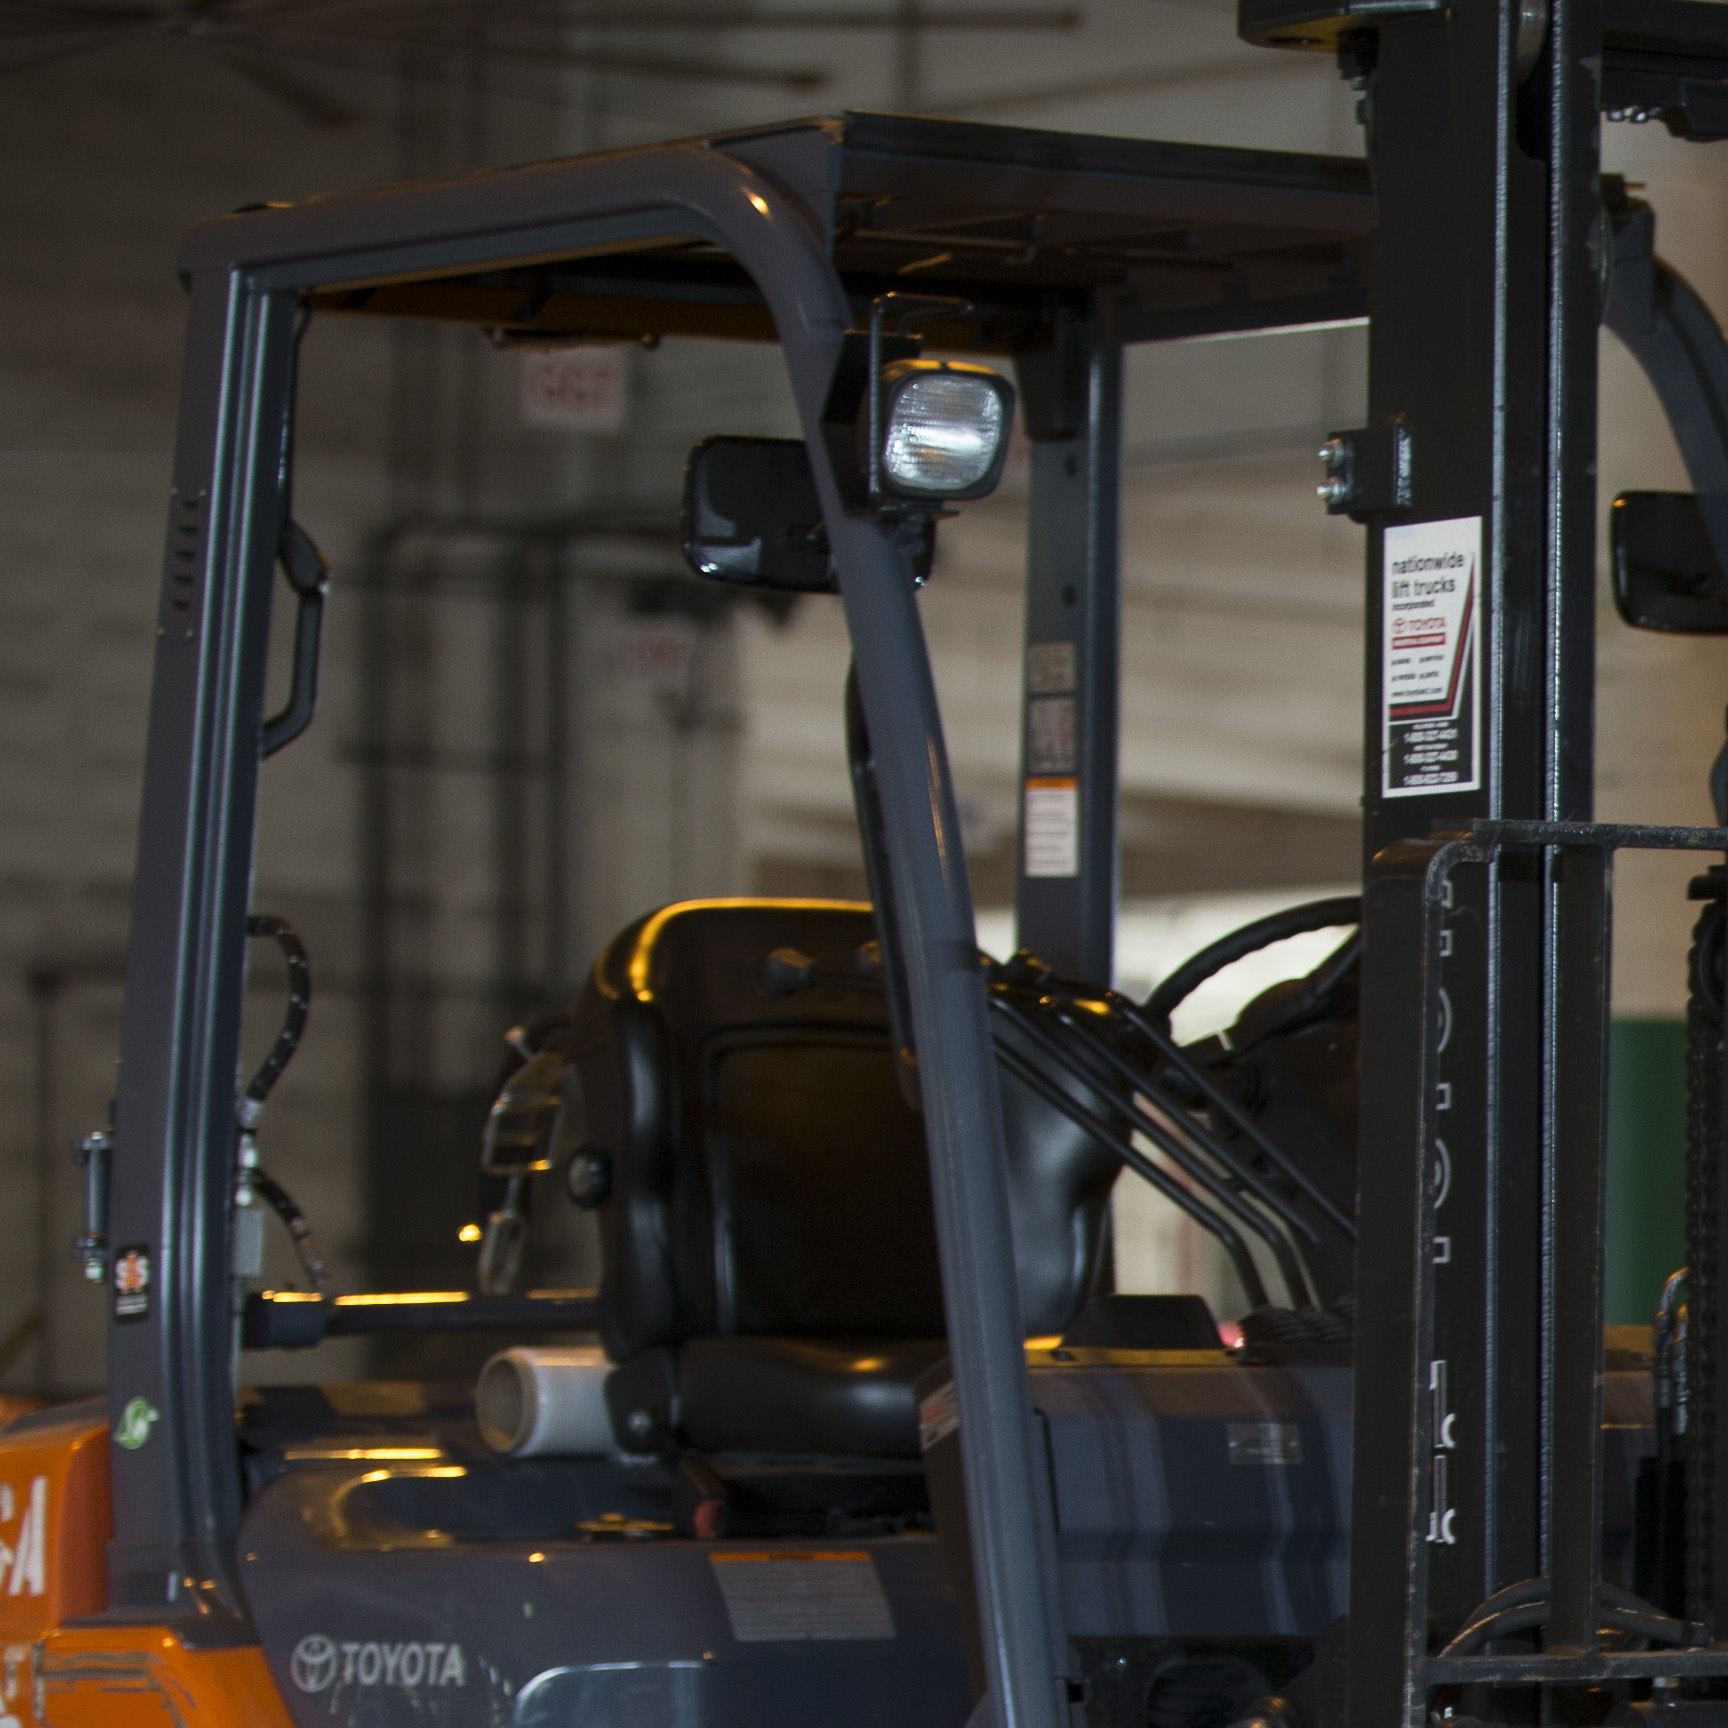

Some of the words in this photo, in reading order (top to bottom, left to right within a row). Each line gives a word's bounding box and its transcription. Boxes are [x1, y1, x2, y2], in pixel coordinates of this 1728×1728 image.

[1391, 552, 1465, 577] nationwide
[1391, 581, 1410, 599] lift
[1414, 577, 1456, 597] trucks
[340, 1641, 466, 1687] TOYOTA
